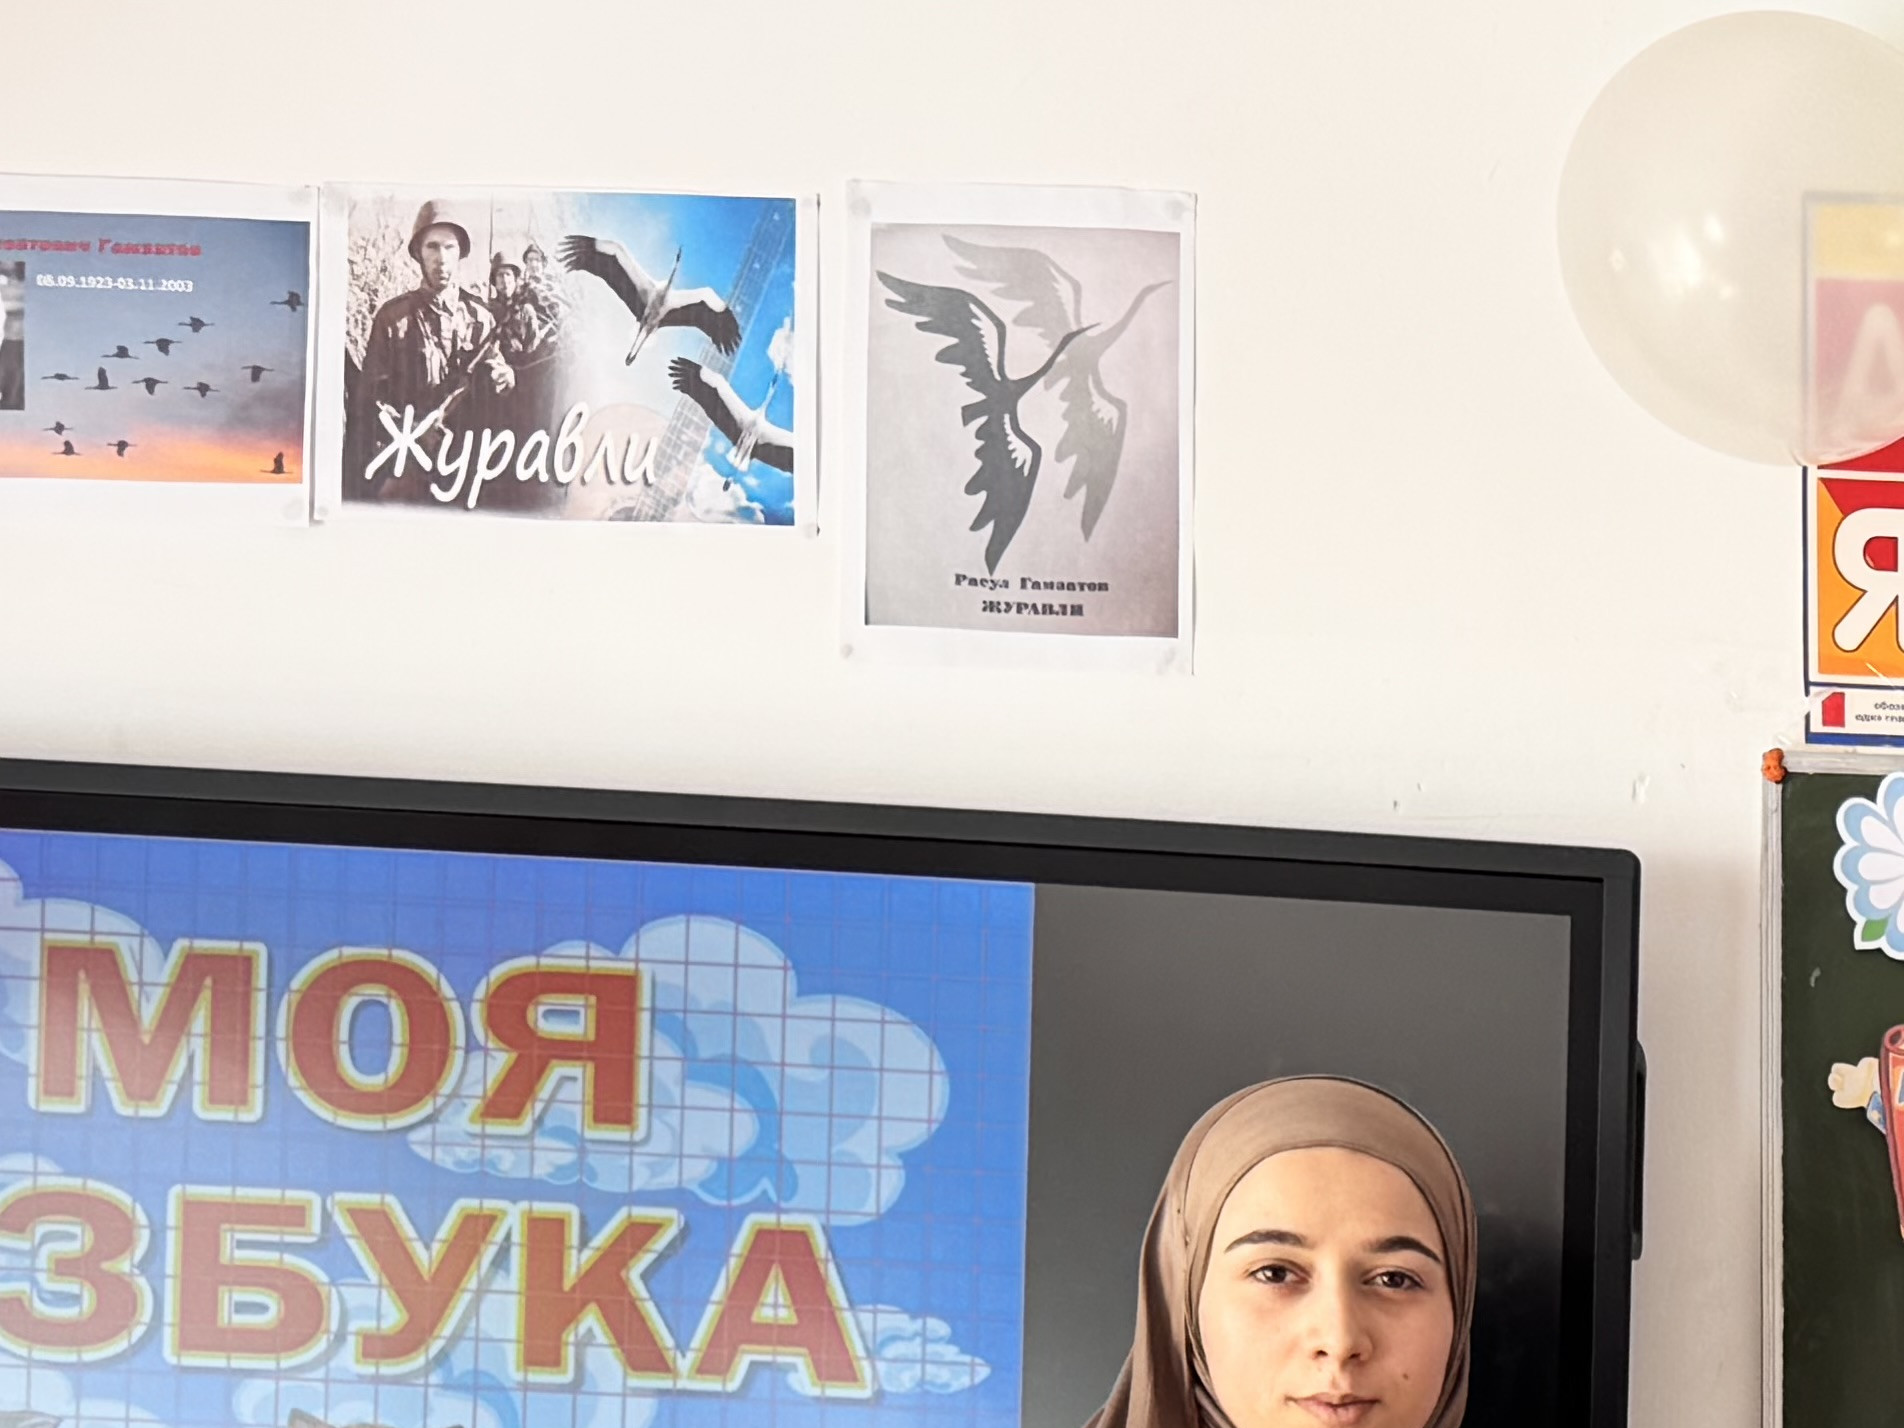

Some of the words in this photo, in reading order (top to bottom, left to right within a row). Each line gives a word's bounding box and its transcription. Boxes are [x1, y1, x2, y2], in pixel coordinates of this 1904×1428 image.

[365, 401, 659, 509] Журавли
[981, 600, 1085, 617] ЖУРАВЛИ
[32, 940, 644, 1140] МОЯ
[0, 1186, 878, 1398] ЗБУКА
